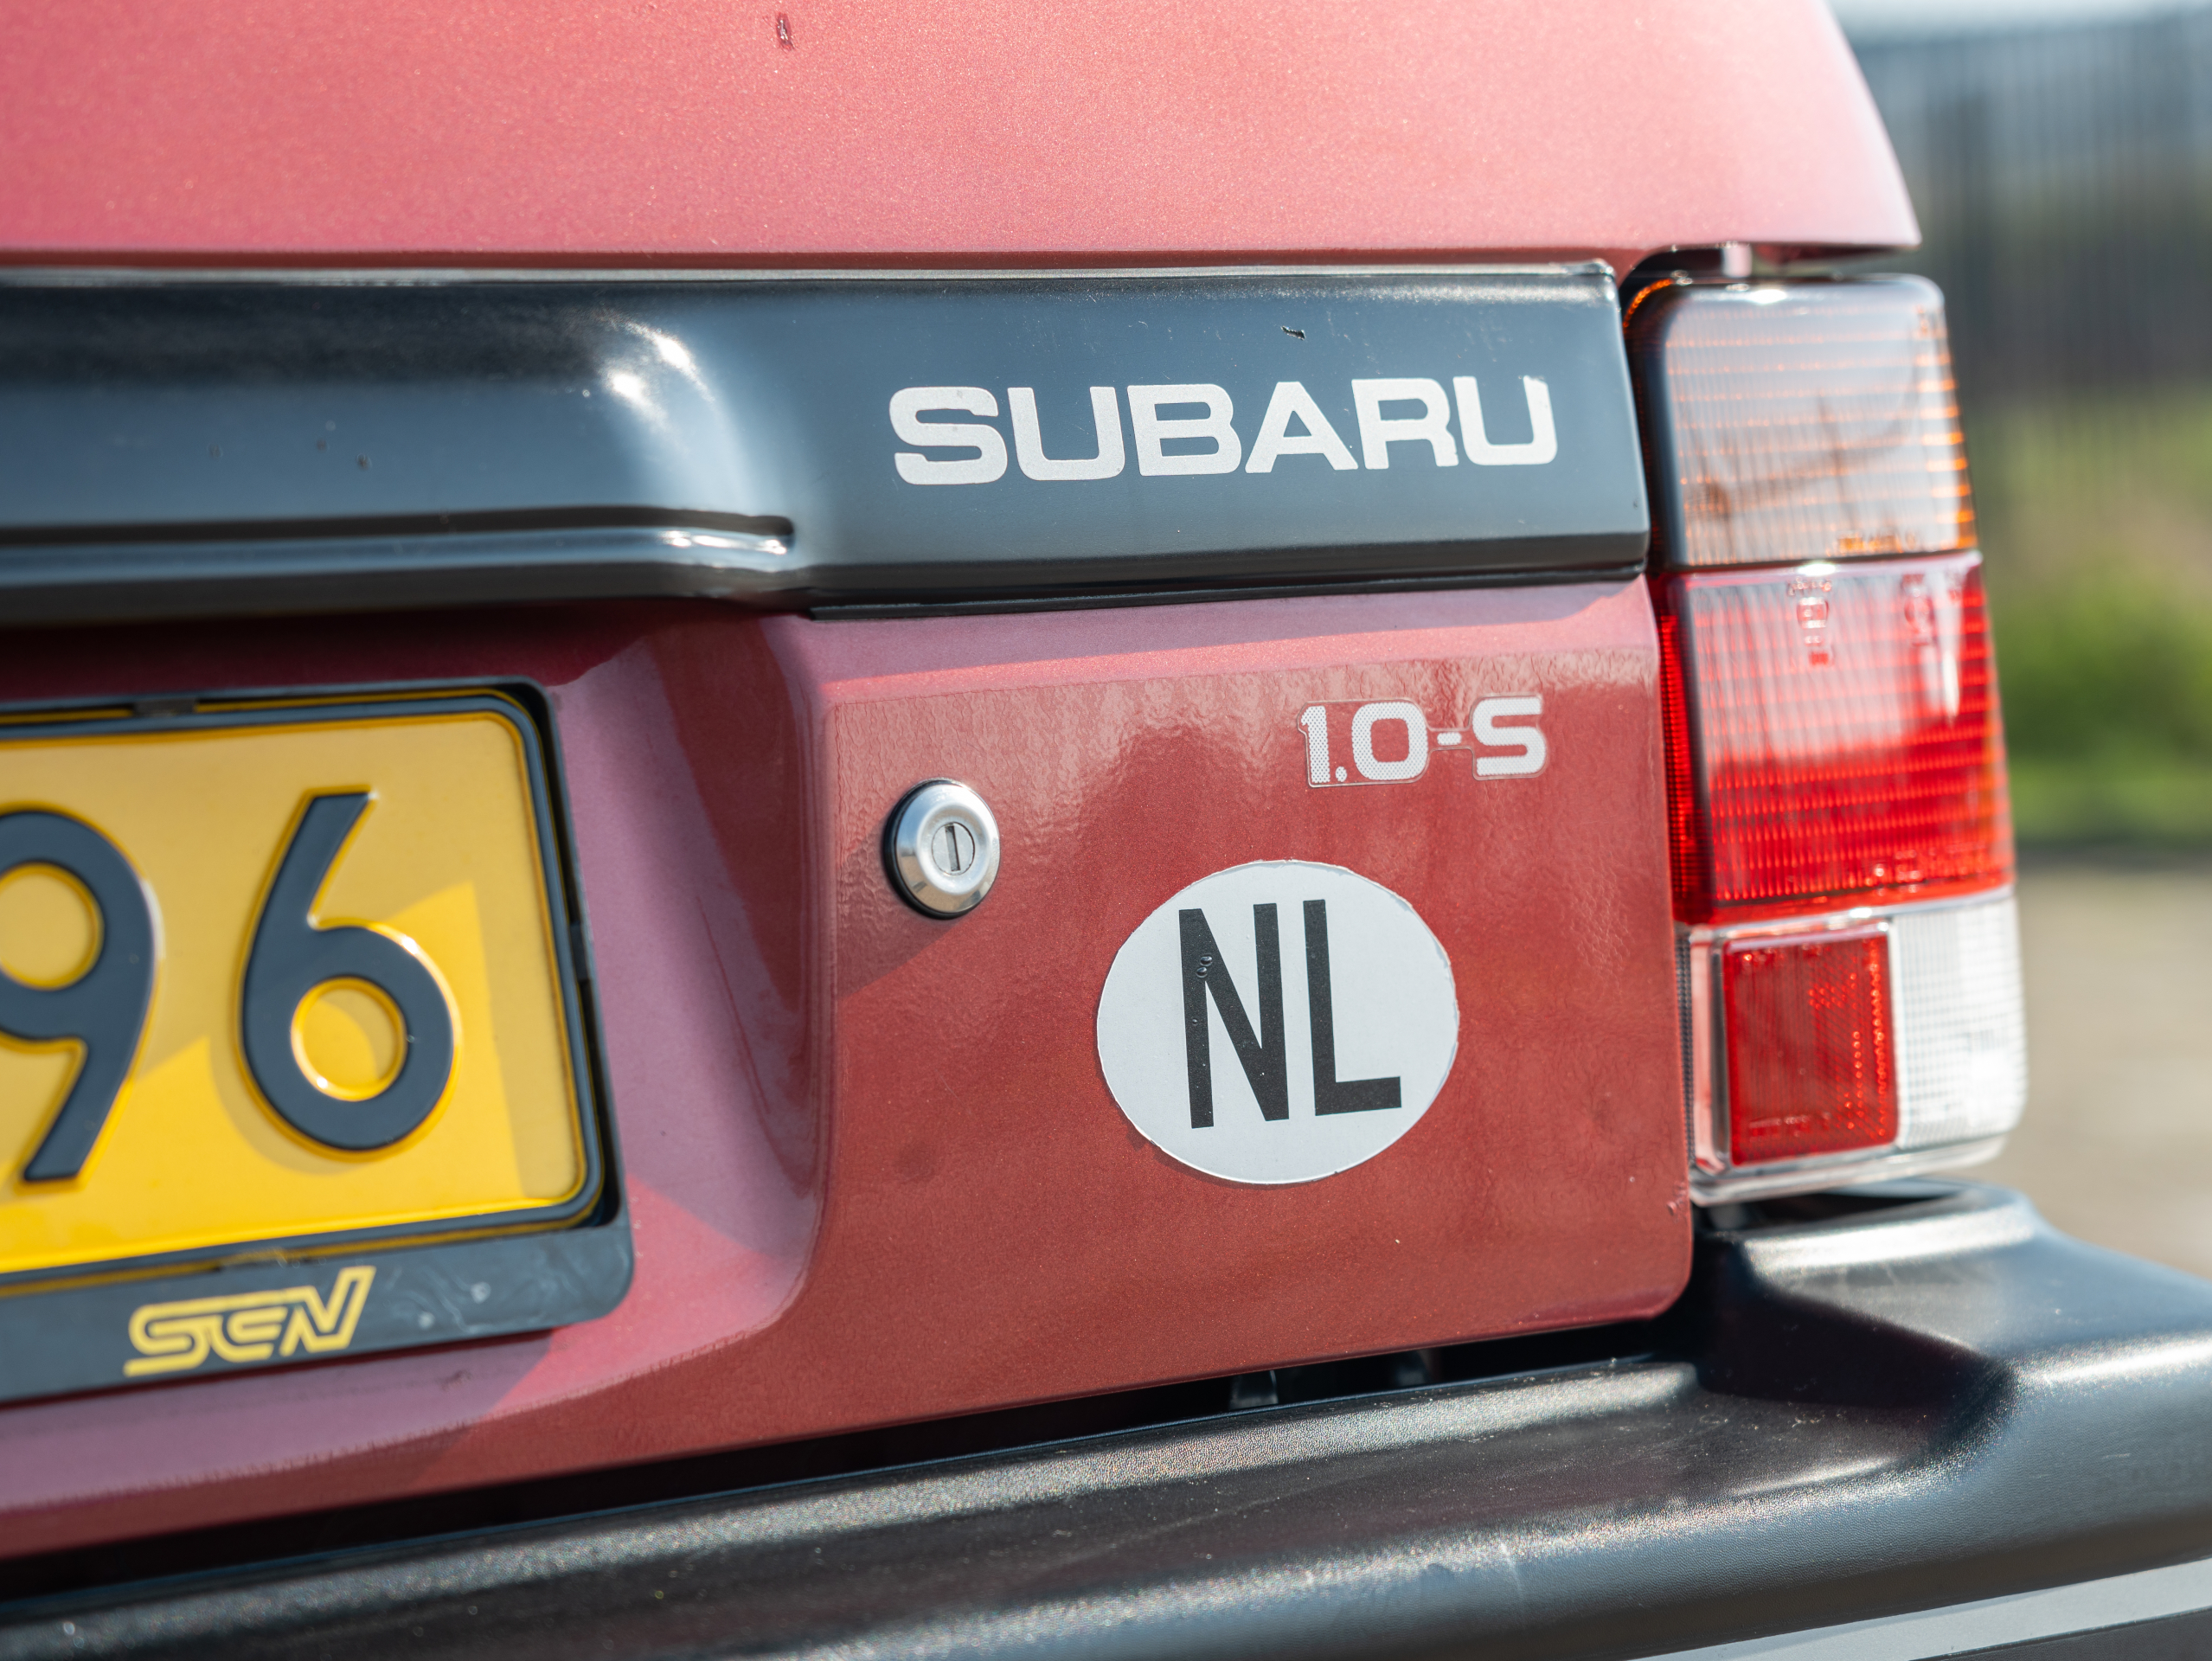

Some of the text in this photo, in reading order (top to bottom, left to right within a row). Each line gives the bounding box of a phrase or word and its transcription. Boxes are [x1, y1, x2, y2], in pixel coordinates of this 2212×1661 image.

[889, 375, 1557, 485] SUBARU
[1301, 697, 1547, 783] 1.0-S
[0, 789, 457, 1182] 96
[1178, 899, 1402, 1129] NL
